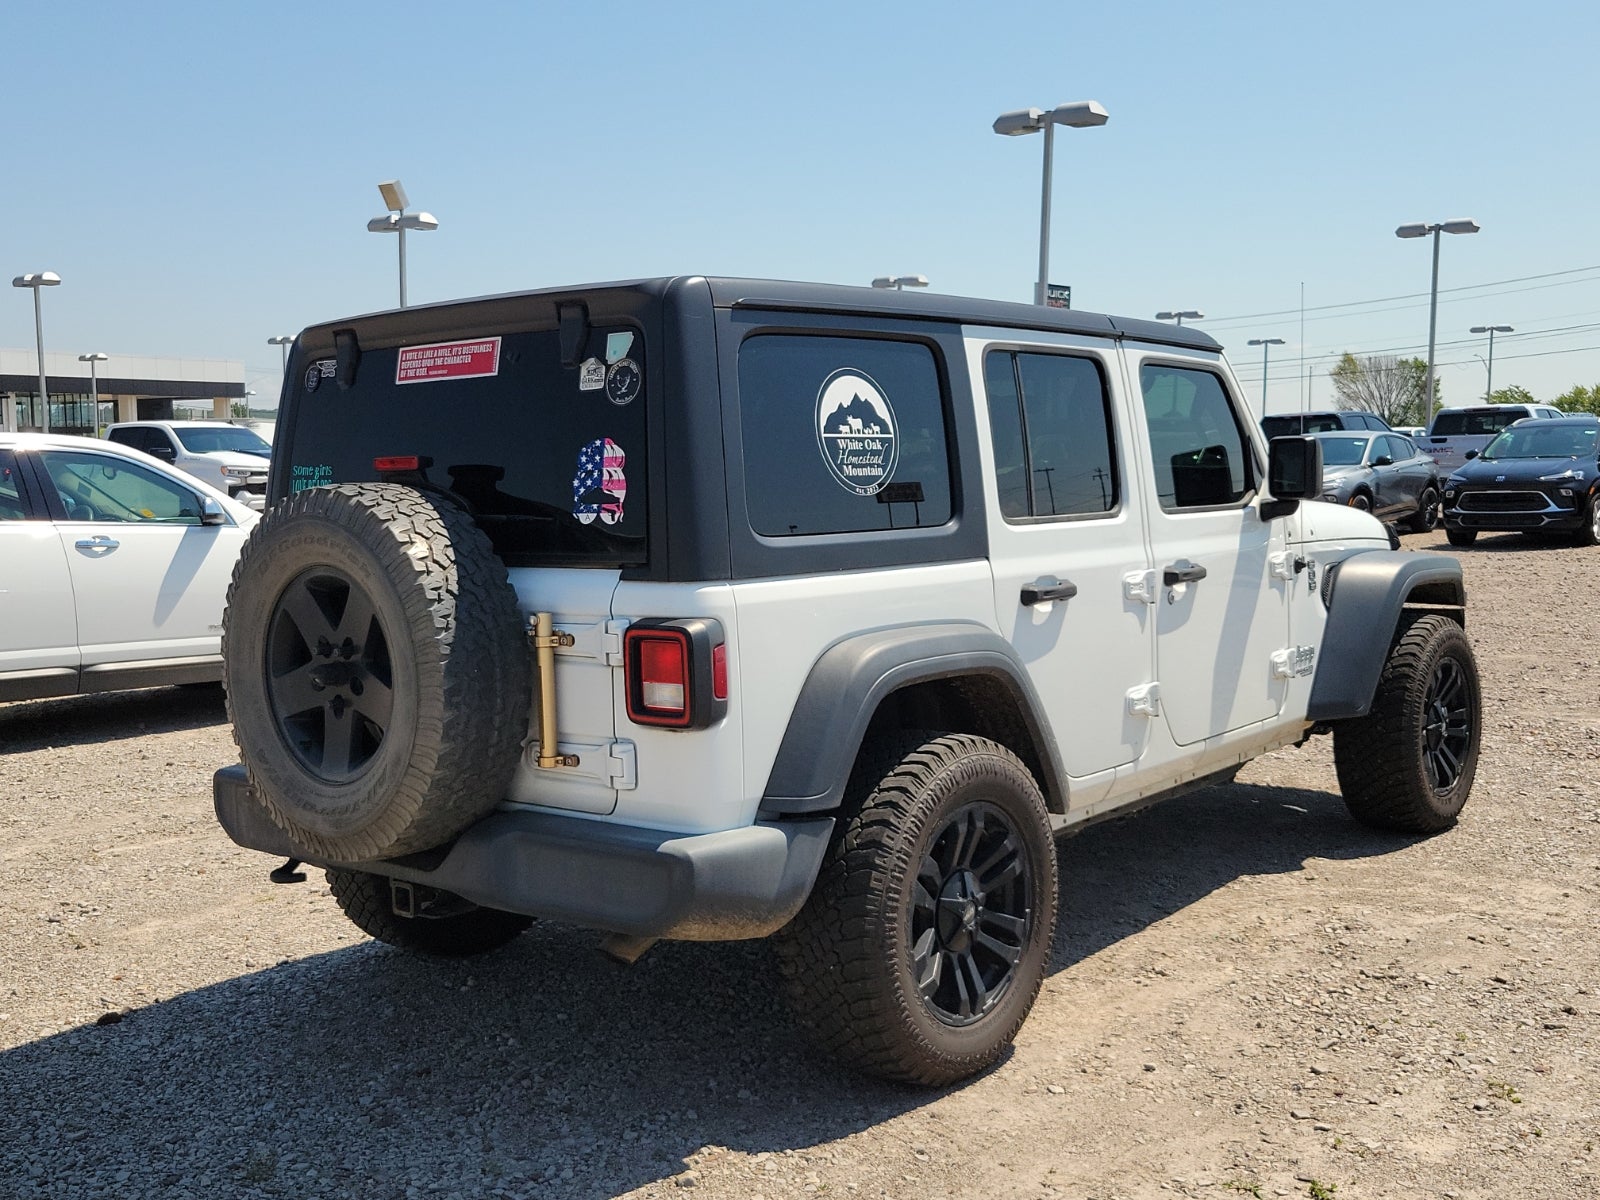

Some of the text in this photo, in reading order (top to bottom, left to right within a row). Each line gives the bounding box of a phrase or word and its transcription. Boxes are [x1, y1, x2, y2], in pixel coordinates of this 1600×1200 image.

[1048, 289, 1069, 299] UICK
[406, 351, 418, 360] VOTE
[462, 344, 493, 355] USEFULNESS
[401, 354, 472, 370] DEPENDS UPON THE CHARACTER
[400, 369, 407, 378] OF
[407, 368, 416, 377] THE
[837, 438, 882, 450] White Oak
[837, 443, 888, 465] Homestead
[843, 465, 883, 476] Mountain
